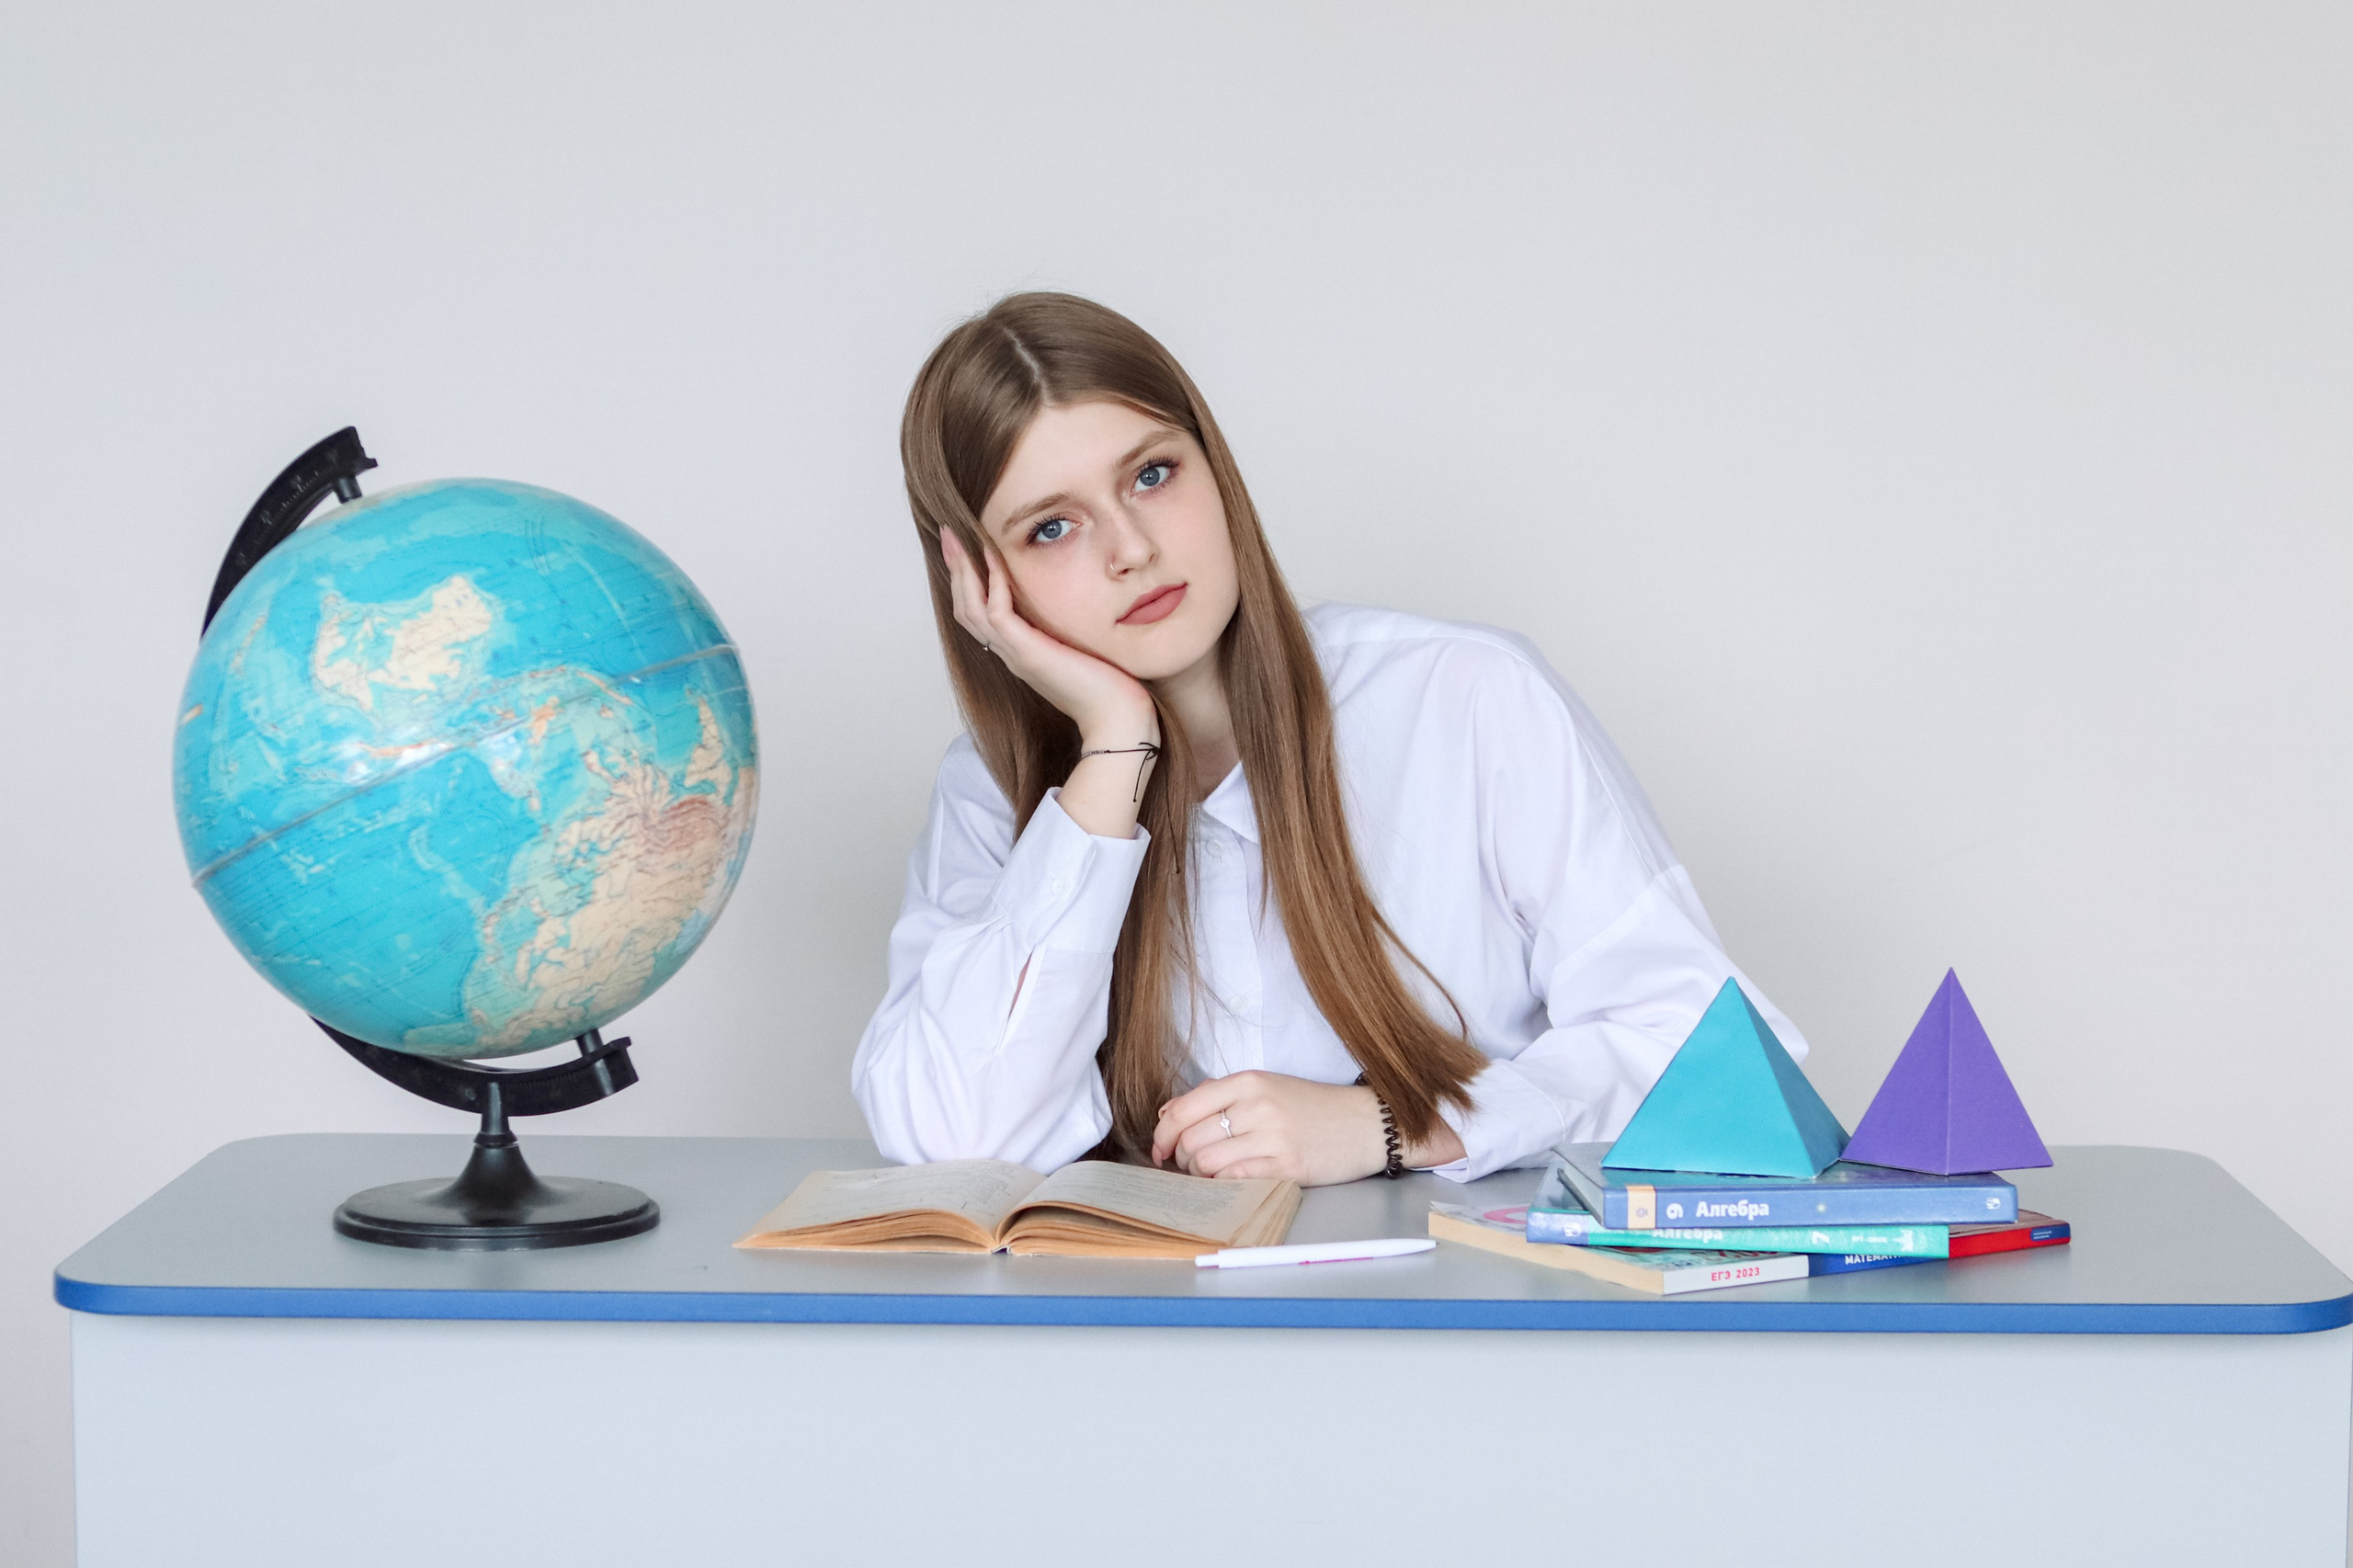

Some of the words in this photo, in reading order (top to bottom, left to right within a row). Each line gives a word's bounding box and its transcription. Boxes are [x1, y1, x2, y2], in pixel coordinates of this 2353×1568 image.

[1695, 1199, 1770, 1221] Алгебра
[1652, 1228, 1723, 1244] Алгебра
[1811, 1231, 1830, 1244] 7
[1844, 1254, 1904, 1266] МАТЕМА
[1711, 1270, 1732, 1282] ЕГЭ
[1735, 1267, 1761, 1279] 2023
